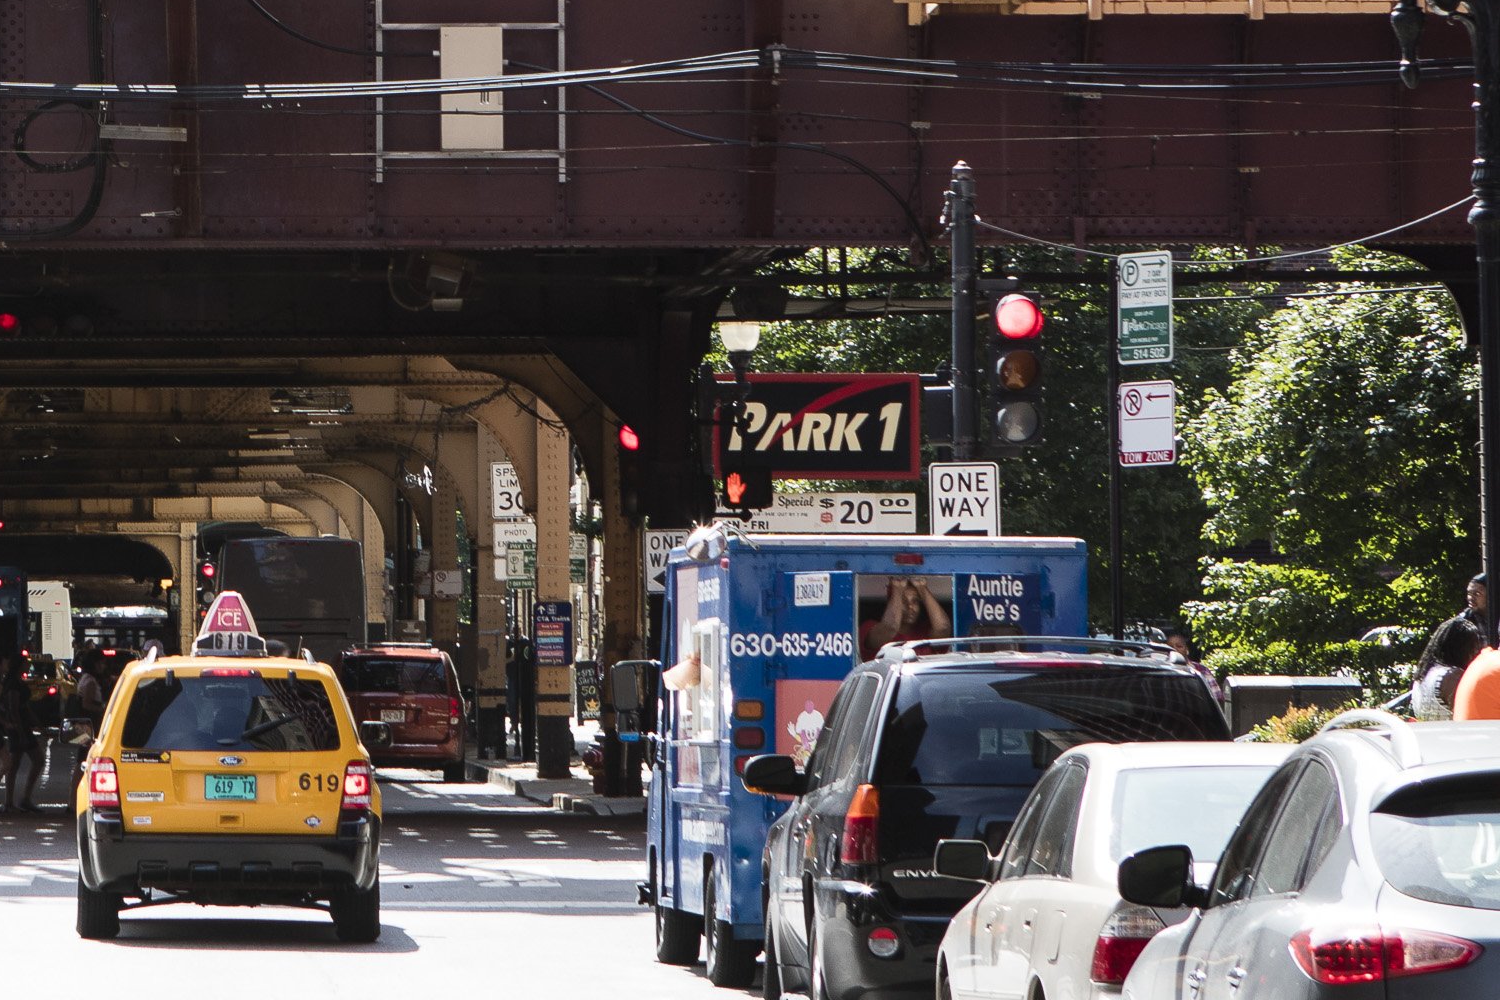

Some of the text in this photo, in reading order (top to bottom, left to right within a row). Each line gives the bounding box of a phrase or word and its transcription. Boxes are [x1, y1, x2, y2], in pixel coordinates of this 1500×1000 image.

[1121, 291, 1132, 299] PAY
[1142, 290, 1152, 298] PAY
[1154, 289, 1167, 297] BOX
[728, 402, 902, 452] PARK 1
[1124, 451, 1169, 463] TOW ZONE
[940, 472, 989, 493] ONE
[778, 495, 814, 509] Special
[840, 500, 873, 525] 20
[879, 498, 910, 508] 00
[939, 497, 990, 518] WAY
[751, 520, 769, 530] FRI
[967, 574, 1024, 597] Auntie
[217, 612, 242, 626] ICE
[972, 599, 1020, 621] Vee's
[214, 632, 245, 650] 619
[730, 632, 853, 657] 630-635-2466
[214, 780, 255, 794] 619 TX
[298, 772, 340, 793] 619
